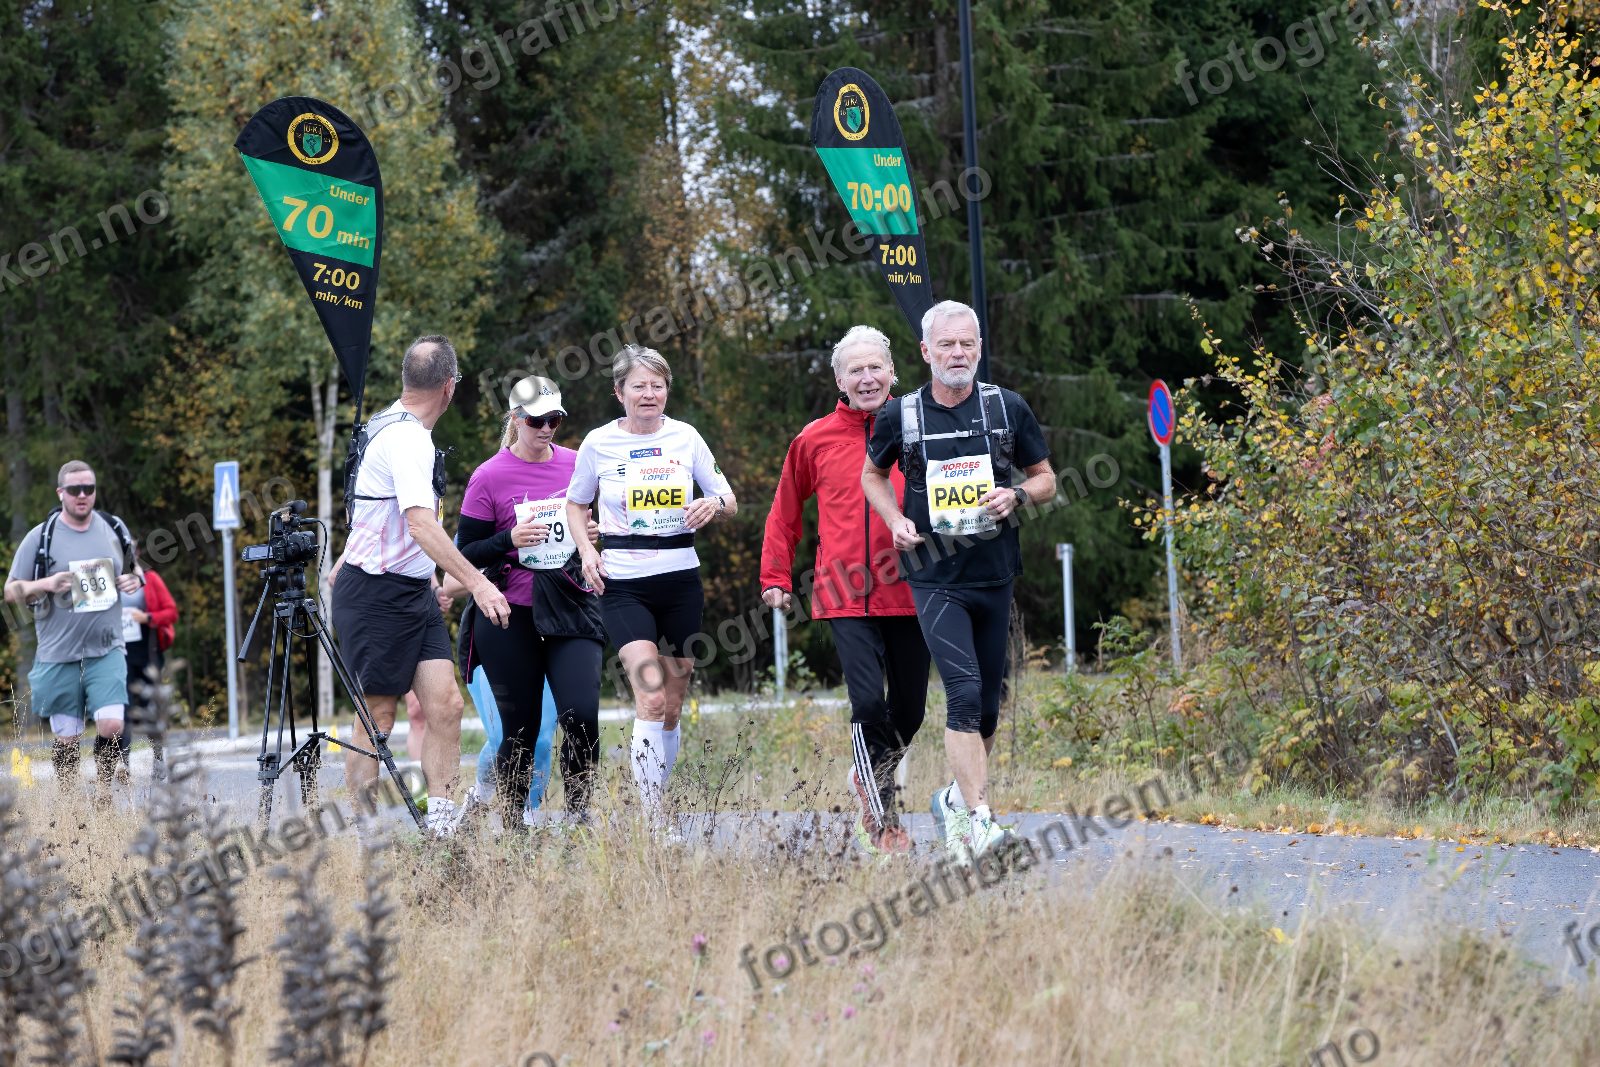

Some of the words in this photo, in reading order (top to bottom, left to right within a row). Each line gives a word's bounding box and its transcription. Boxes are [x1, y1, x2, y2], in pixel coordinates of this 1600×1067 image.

[873, 153, 902, 168] Under
[329, 184, 370, 206] Under
[847, 182, 911, 213] 70:00
[282, 195, 334, 239] 70
[336, 228, 370, 250] min
[879, 244, 917, 267] 7:00
[312, 262, 360, 291] 7:00
[887, 271, 922, 286] min/km
[315, 289, 363, 311] min/km
[639, 467, 676, 475] NORGES
[940, 461, 981, 472] NORGES
[944, 468, 975, 479] LØPET
[632, 488, 682, 508] PACE
[529, 503, 562, 513] NORGES
[80, 577, 107, 593] 693
